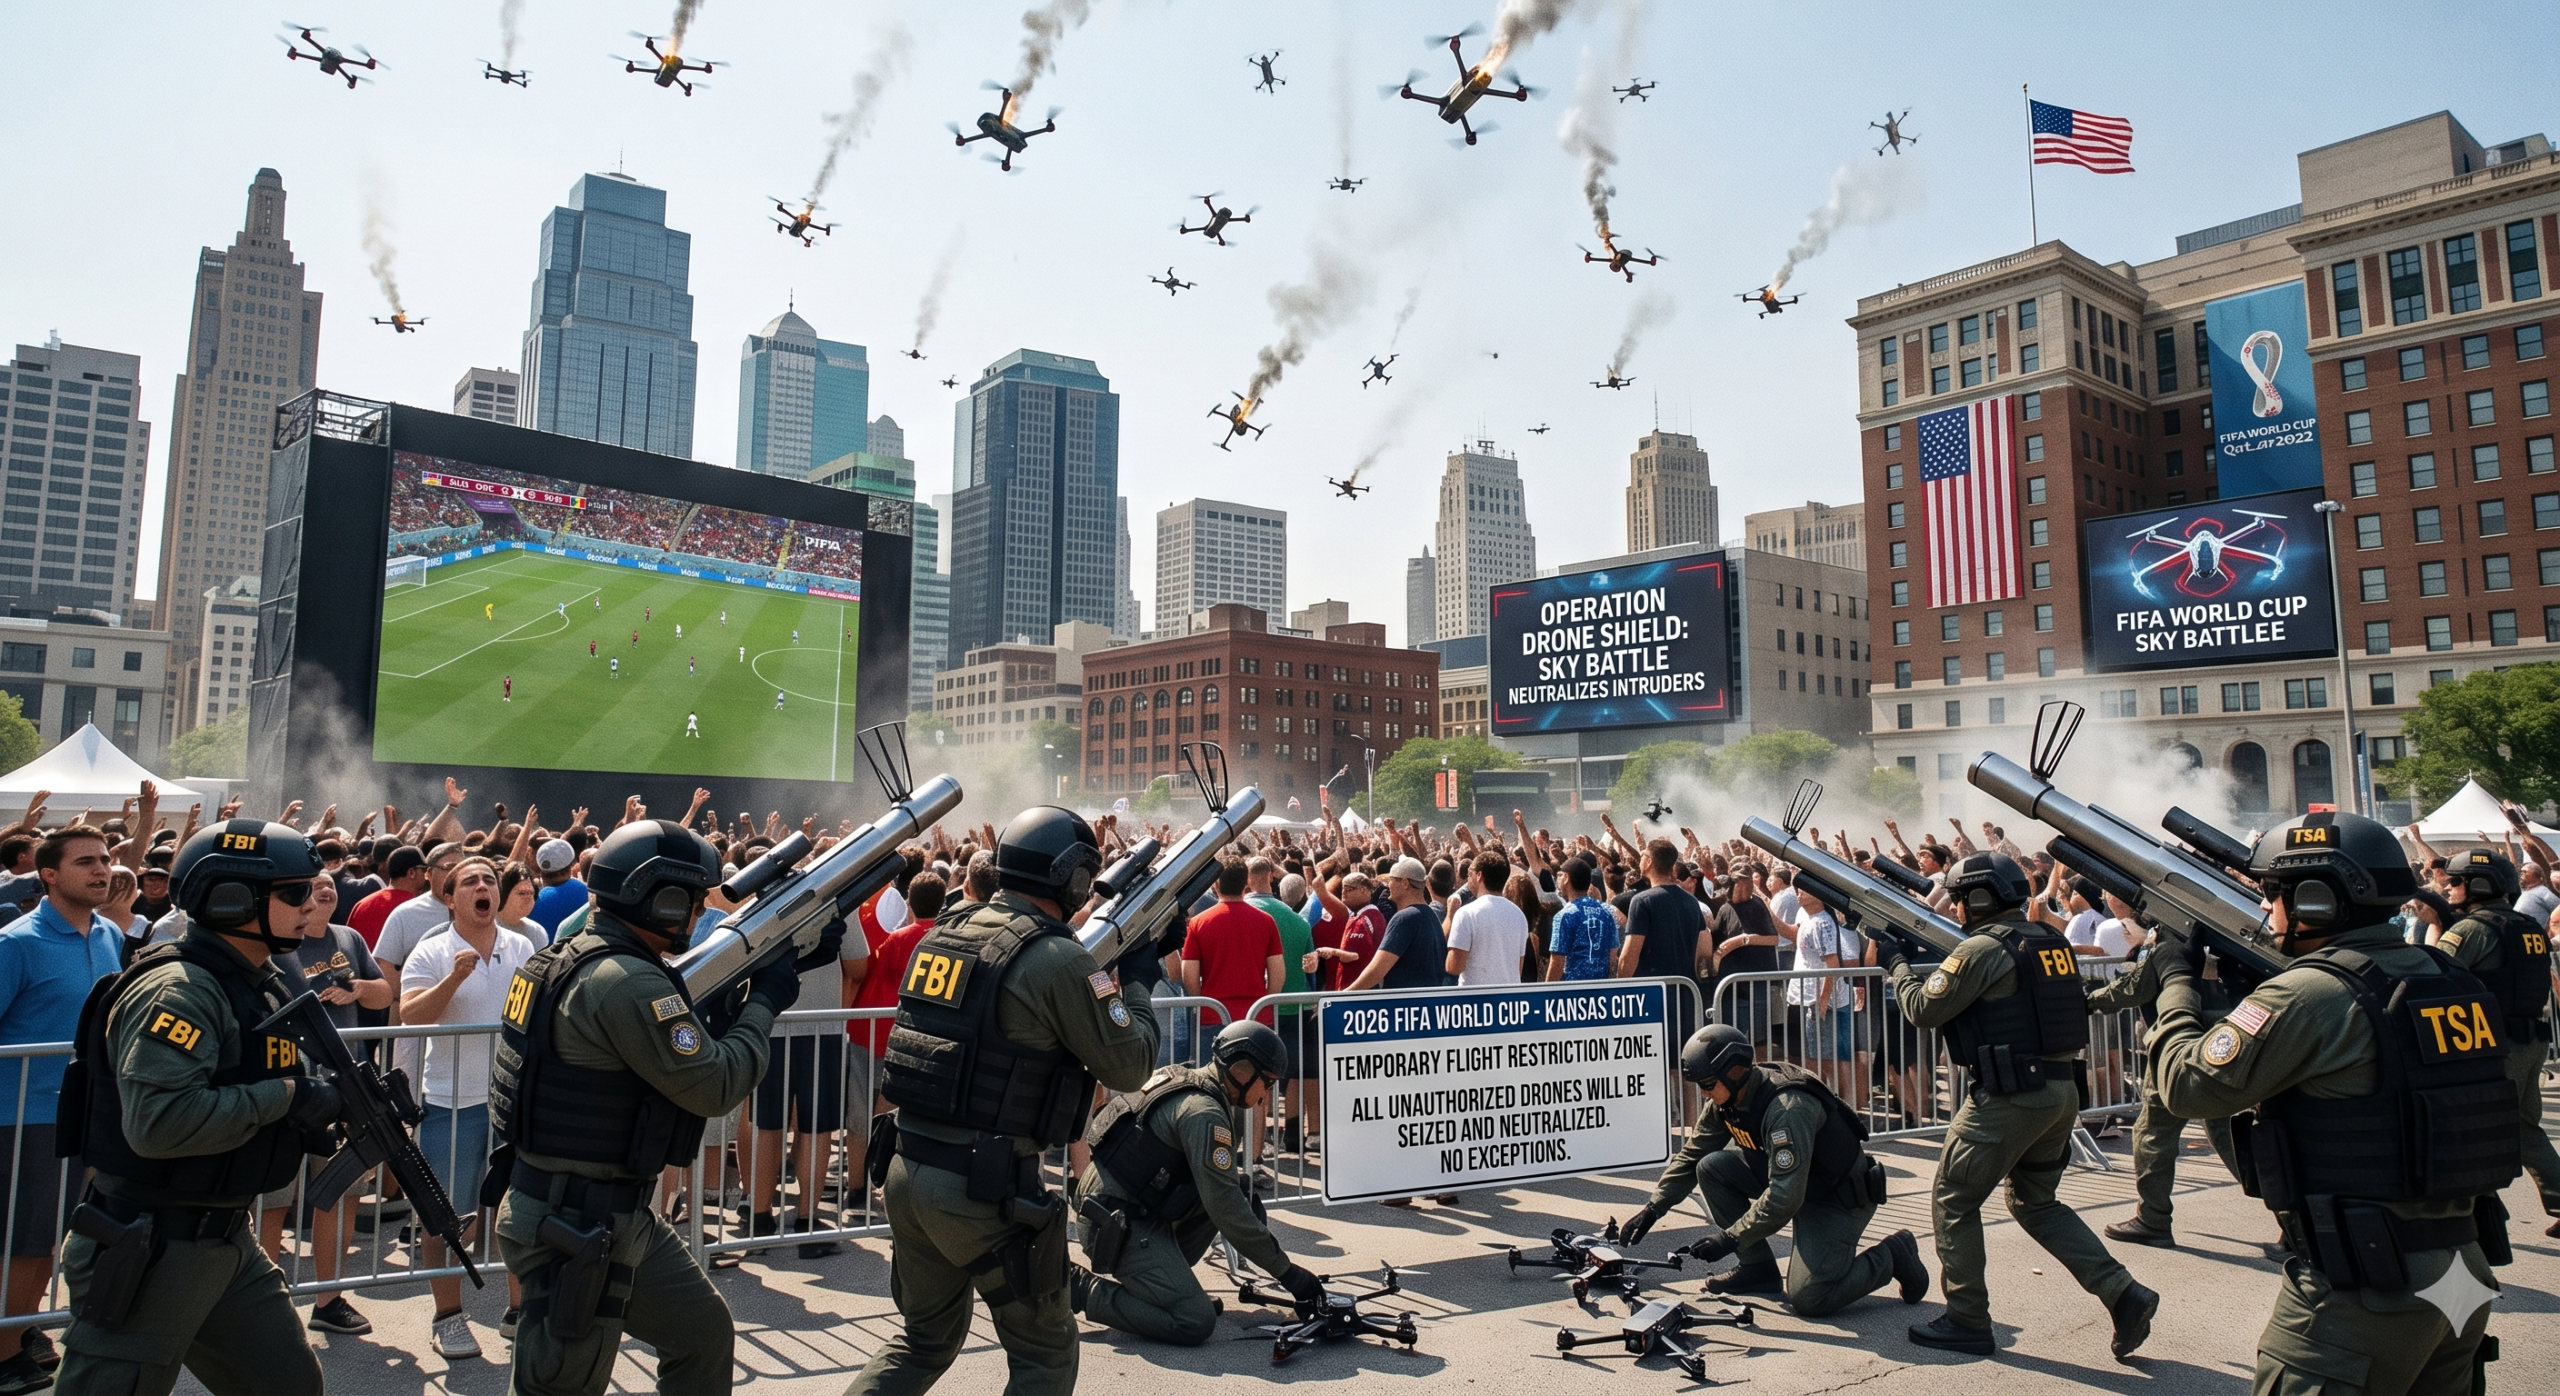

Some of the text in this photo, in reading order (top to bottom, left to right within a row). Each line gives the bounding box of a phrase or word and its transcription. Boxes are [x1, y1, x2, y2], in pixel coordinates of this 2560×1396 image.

[2220, 418, 2316, 443] FIFA WORLD CUP
[1541, 587, 1666, 625] OPERATION
[2116, 595, 2307, 631] FIFA WORLD CUP
[1523, 615, 1688, 656] DRONE SHIELD:
[2135, 620, 2286, 652] SKY BATTLEE
[1538, 645, 1669, 681] SKY BATTLE
[1508, 672, 1705, 705] NEUTRALIZES INTRUDERS
[222, 833, 257, 850] FBI
[2293, 827, 2327, 844] TSA
[2038, 947, 2076, 977] FBI
[2522, 933, 2547, 955] FBI
[906, 951, 964, 1001] FBI
[503, 974, 534, 1026] FBI
[1343, 1008, 1389, 1035] 2026
[1394, 1006, 1431, 1033] FIFA
[1435, 1002, 1494, 1030] WORLD
[1498, 1000, 1530, 1026] CUP
[1545, 996, 1608, 1023] KANSAS
[1611, 993, 1649, 1019] CITY.
[150, 1011, 202, 1051] FBI
[2420, 1002, 2497, 1054] TSA
[266, 1035, 297, 1070] FBI
[1333, 1035, 1658, 1082] TEMPORARY FLIGHT RESTRICTION ZONE.
[1351, 1073, 1646, 1122] ALL UNAUTHORIZED DRONES WILL BE
[1397, 1105, 1610, 1148] SEIZED AND NEUTRALIZED.
[1440, 1138, 1572, 1174] NO EXCEPTIONS.
